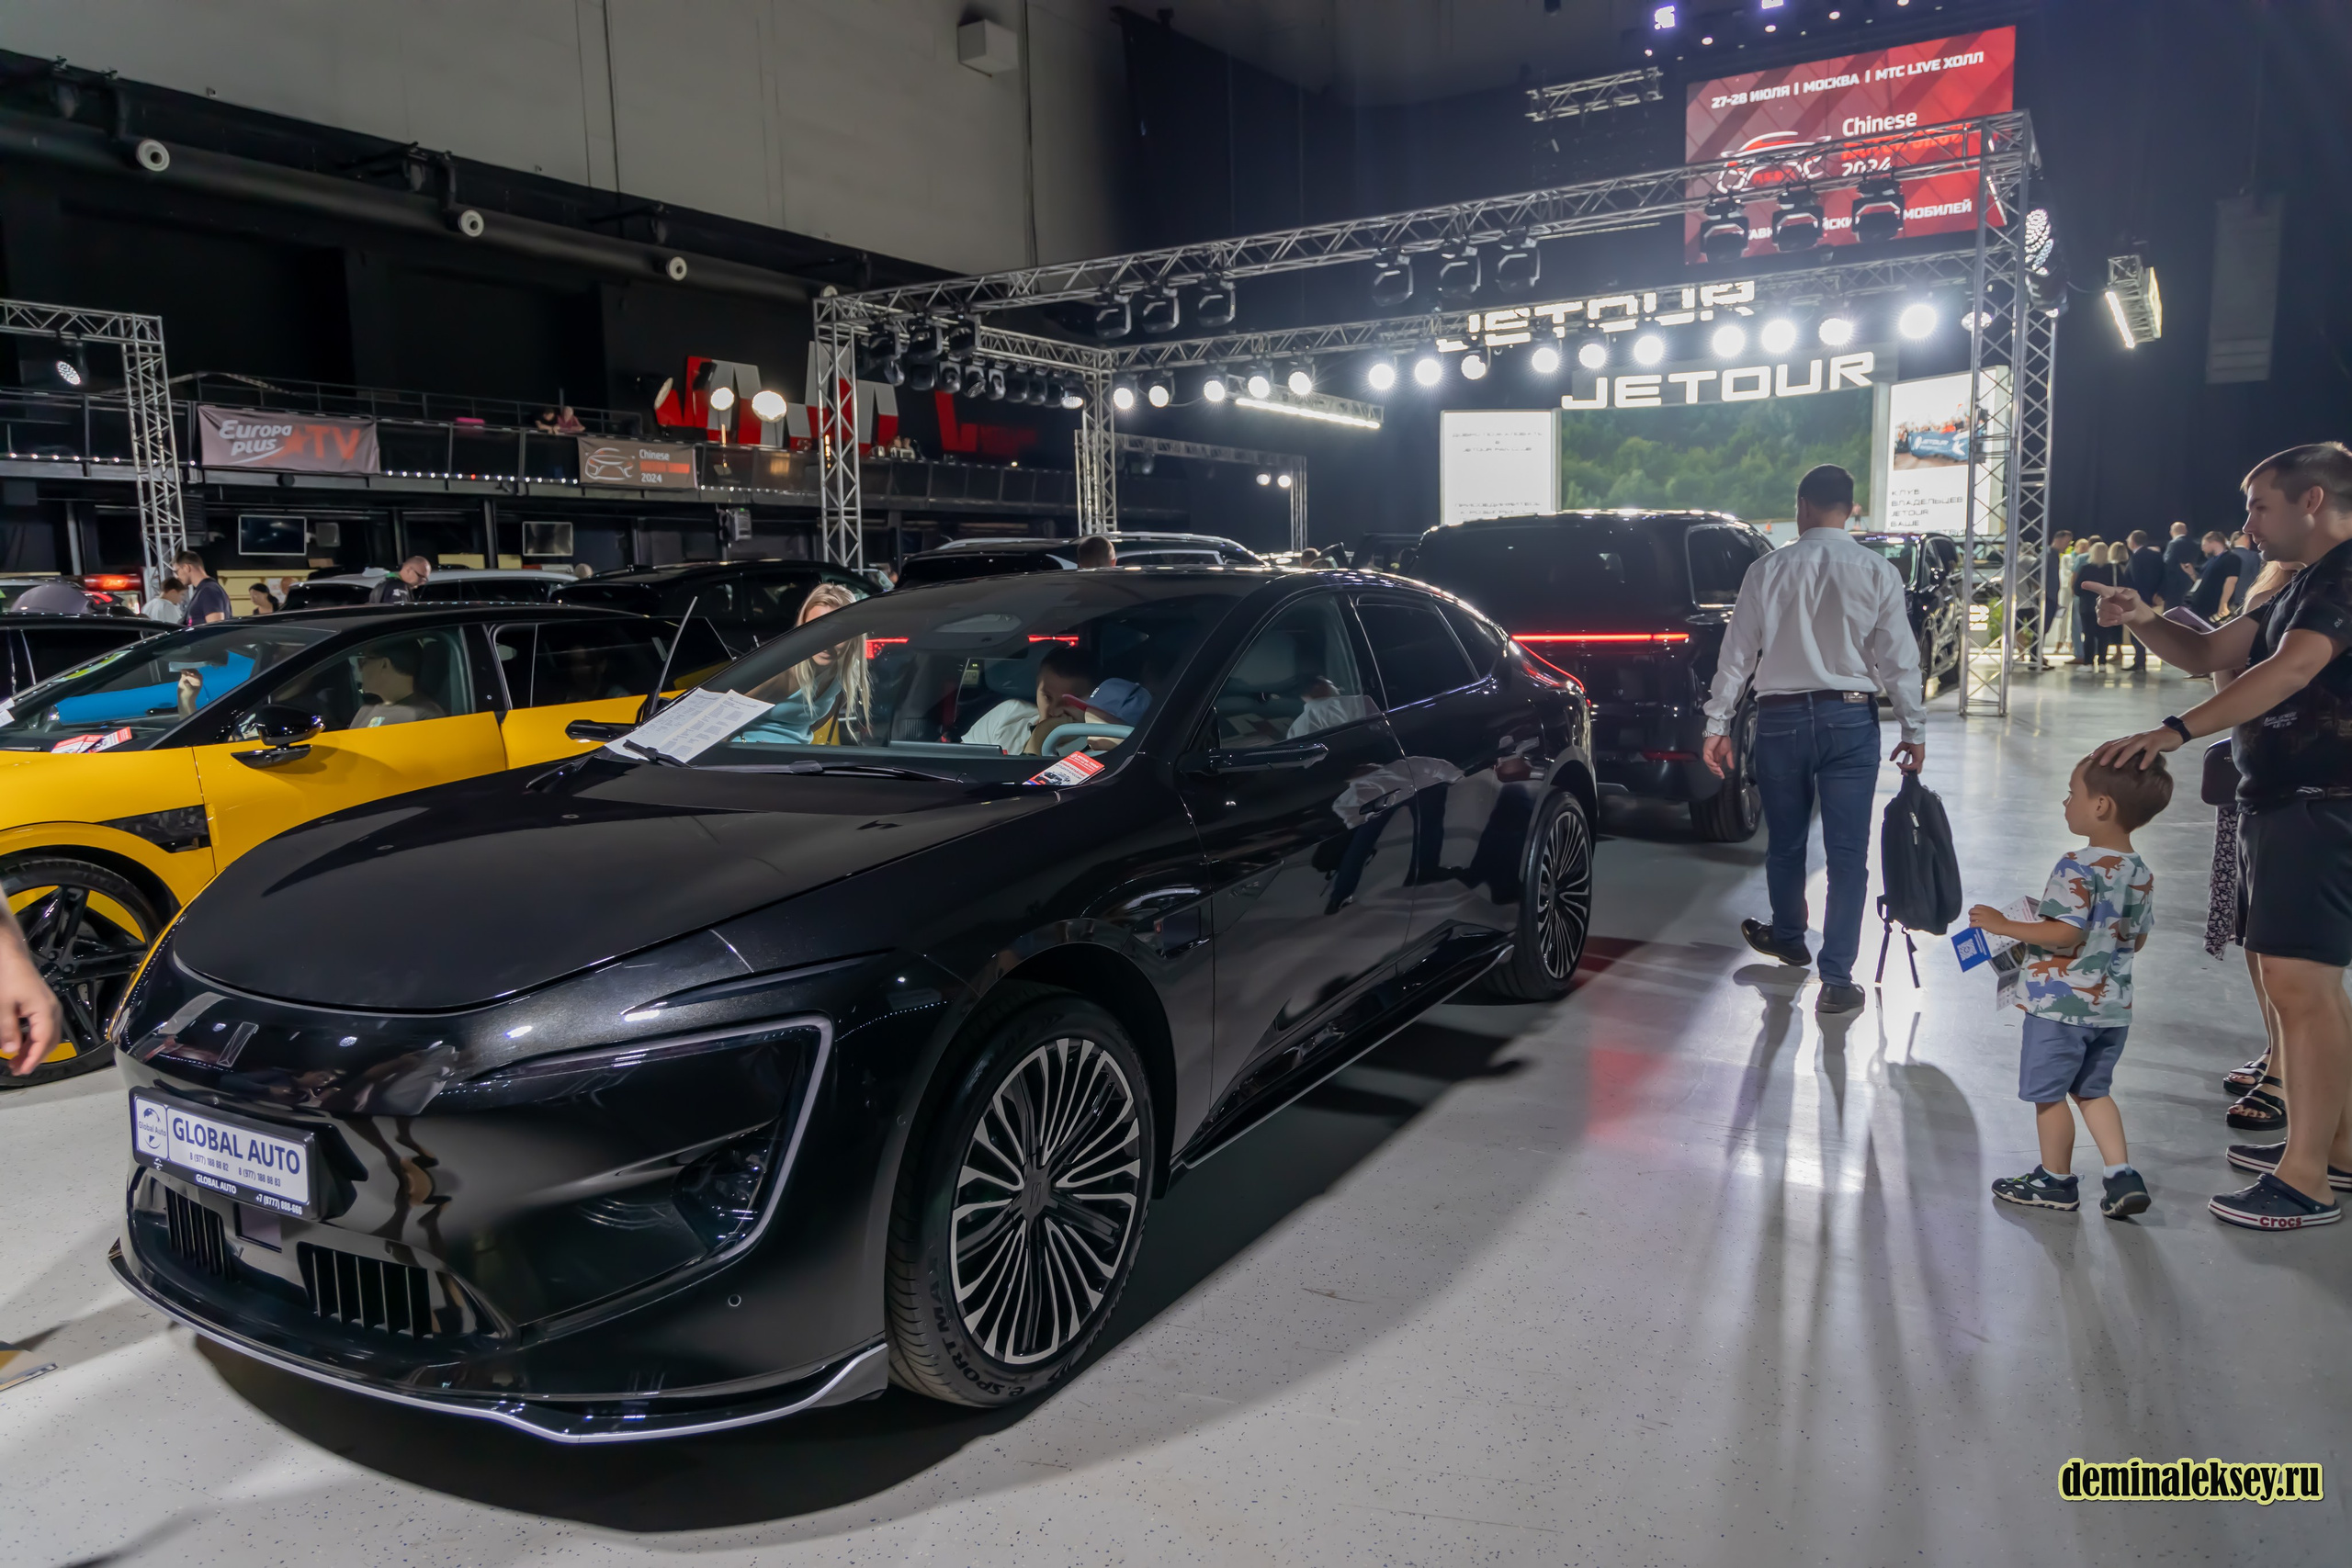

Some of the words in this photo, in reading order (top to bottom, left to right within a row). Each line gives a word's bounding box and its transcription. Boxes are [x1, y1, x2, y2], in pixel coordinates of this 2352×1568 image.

[1711, 92, 1747, 108] 27-28
[1749, 85, 1791, 102] ИЮЛЯ
[1803, 73, 1860, 93] МОСКВА
[1906, 59, 1940, 76] LIVE
[1943, 51, 1984, 70] ХОЛЛ
[1842, 112, 1917, 137] Chinese
[1903, 198, 1973, 220] МОБИЛЕЙ
[1561, 352, 1874, 410] JETOUR
[219, 419, 292, 439] Europa
[304, 424, 360, 460] TV
[639, 448, 670, 461] Chinese
[640, 473, 662, 483] 2024
[1891, 509, 1929, 517] JETOUR
[138, 1121, 154, 1133] Global
[155, 1126, 166, 1137] Auto
[173, 1117, 243, 1160] GLOBAL
[247, 1139, 300, 1175] AUTO
[195, 1173, 220, 1190] GLOBAL
[220, 1179, 237, 1194] AUTO
[2259, 1215, 2302, 1228] crocs
